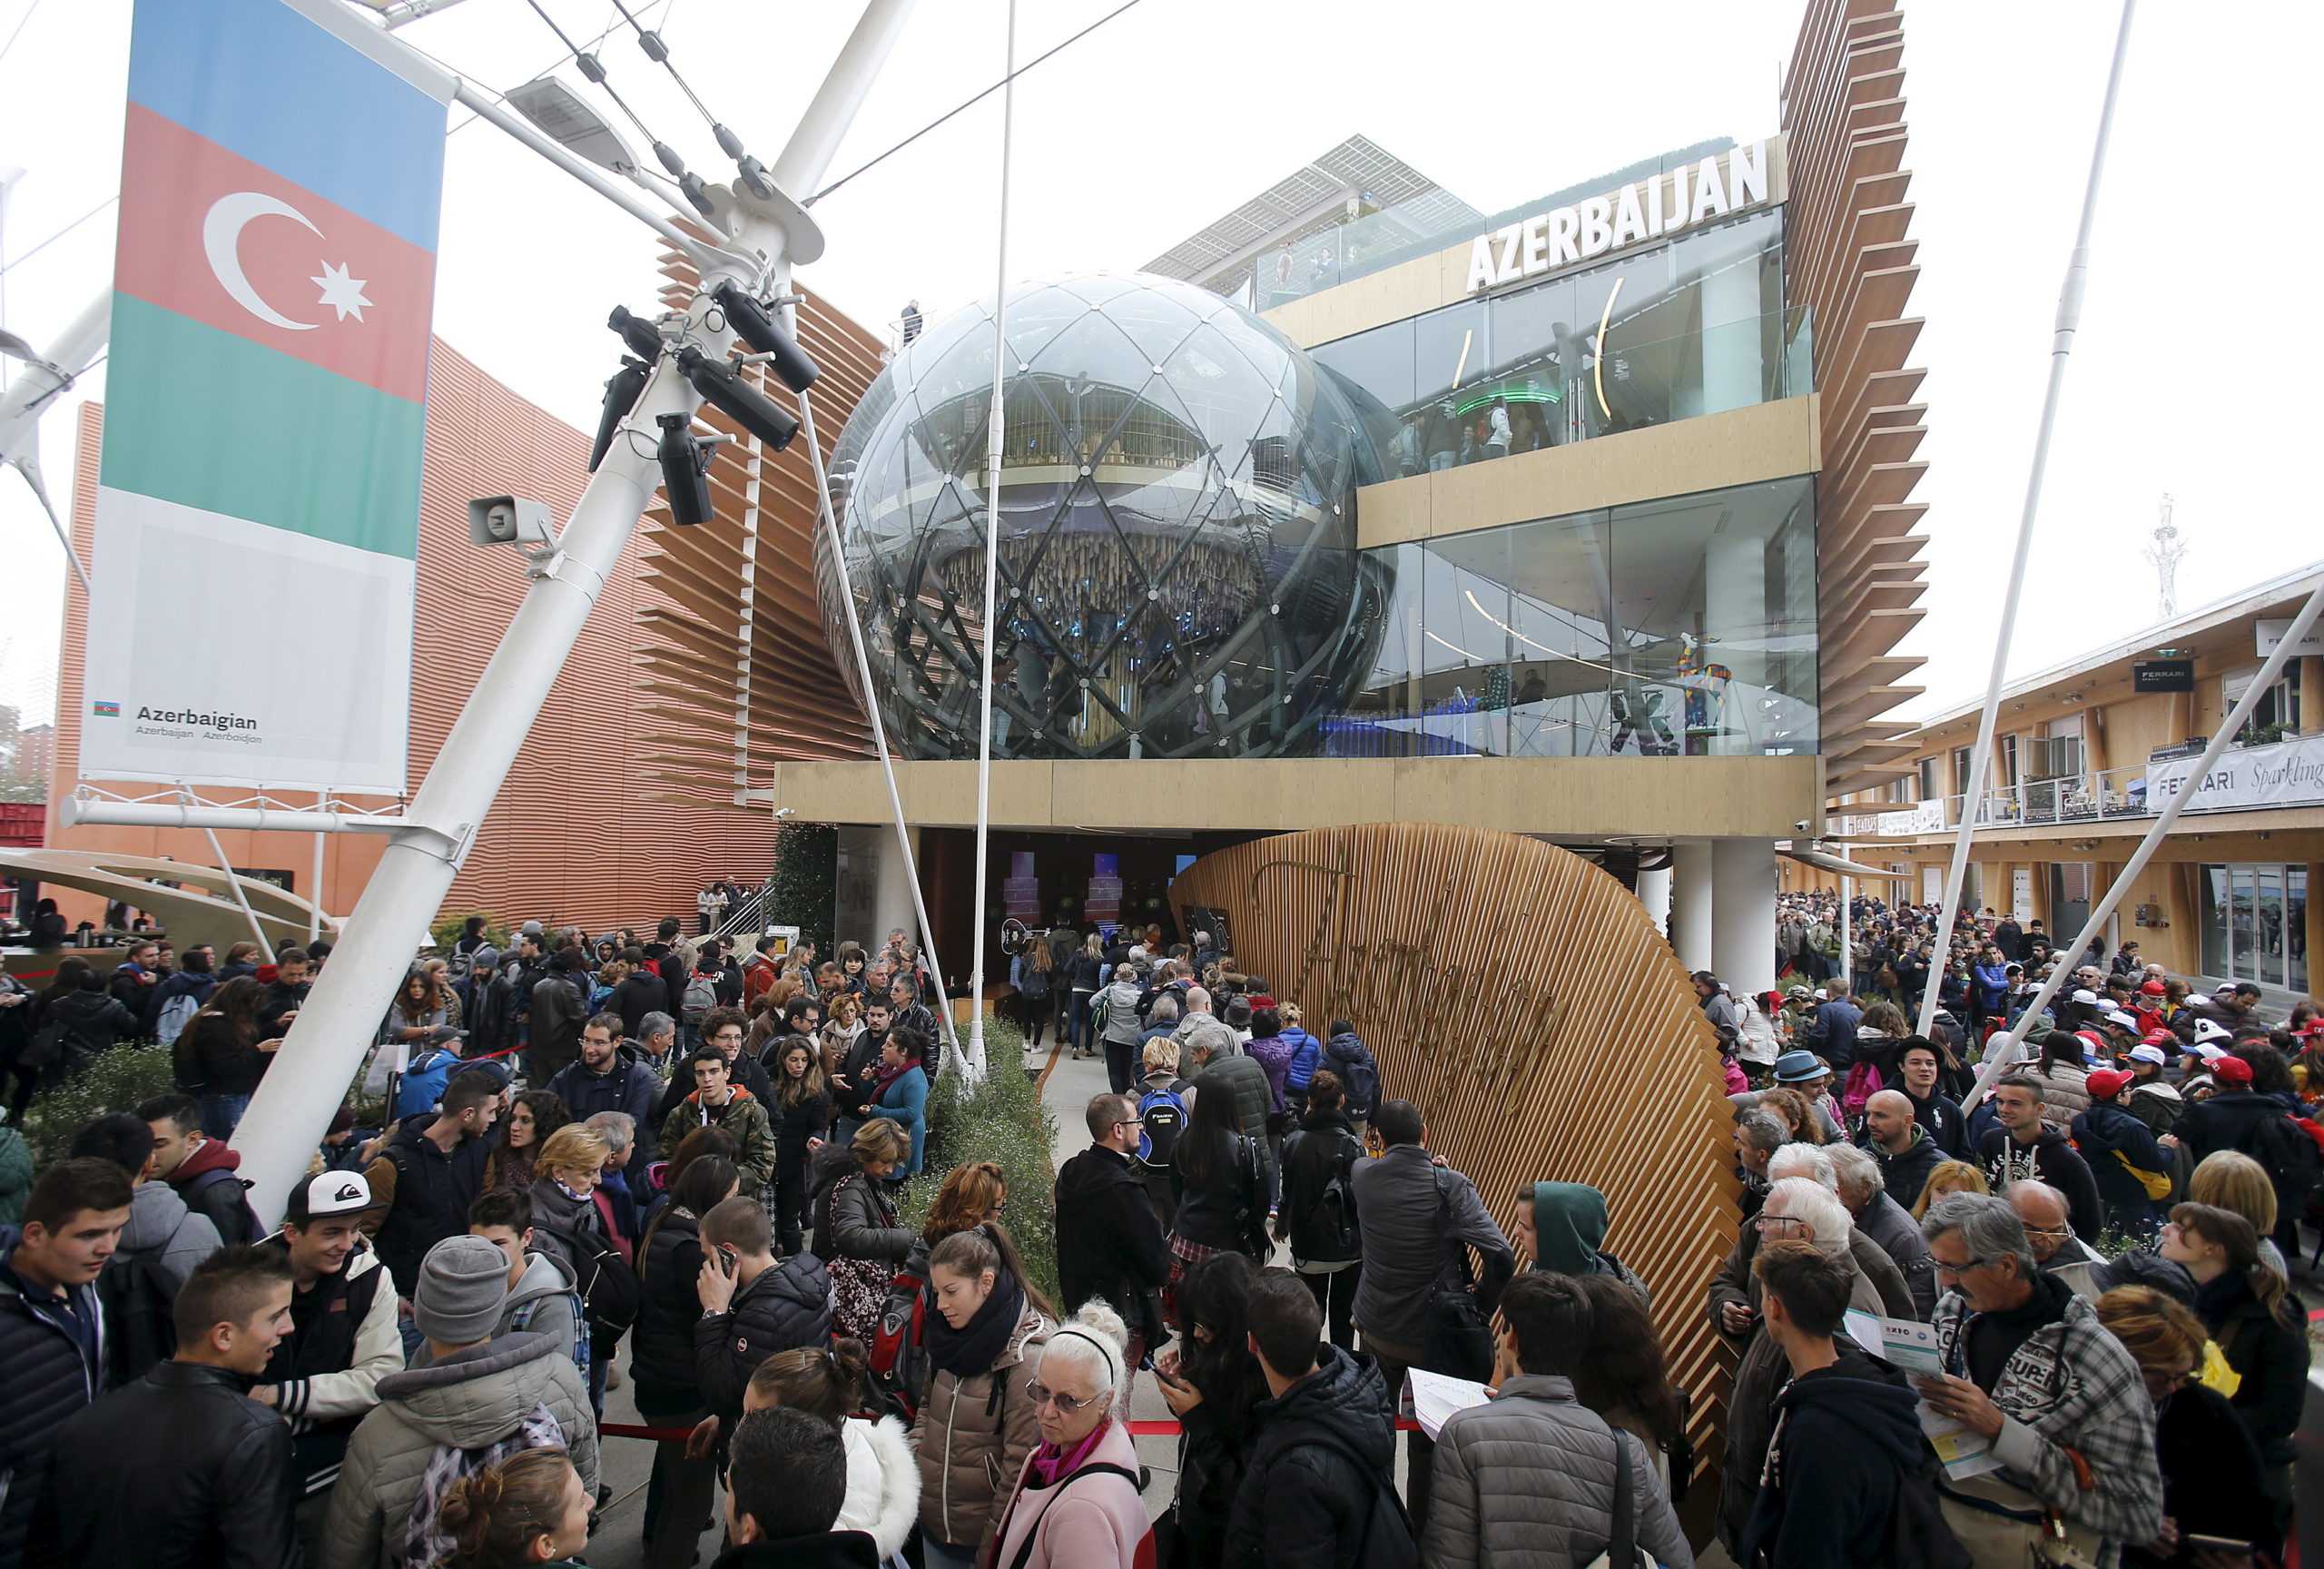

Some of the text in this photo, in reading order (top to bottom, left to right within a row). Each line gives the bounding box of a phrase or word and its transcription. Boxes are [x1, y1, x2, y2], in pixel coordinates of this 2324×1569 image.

[1467, 140, 1768, 294] AZERBAIJAN
[136, 725, 194, 740] Azerbaijan
[137, 706, 258, 731] Azerbaigian
[2250, 755, 2324, 794] Sparkling
